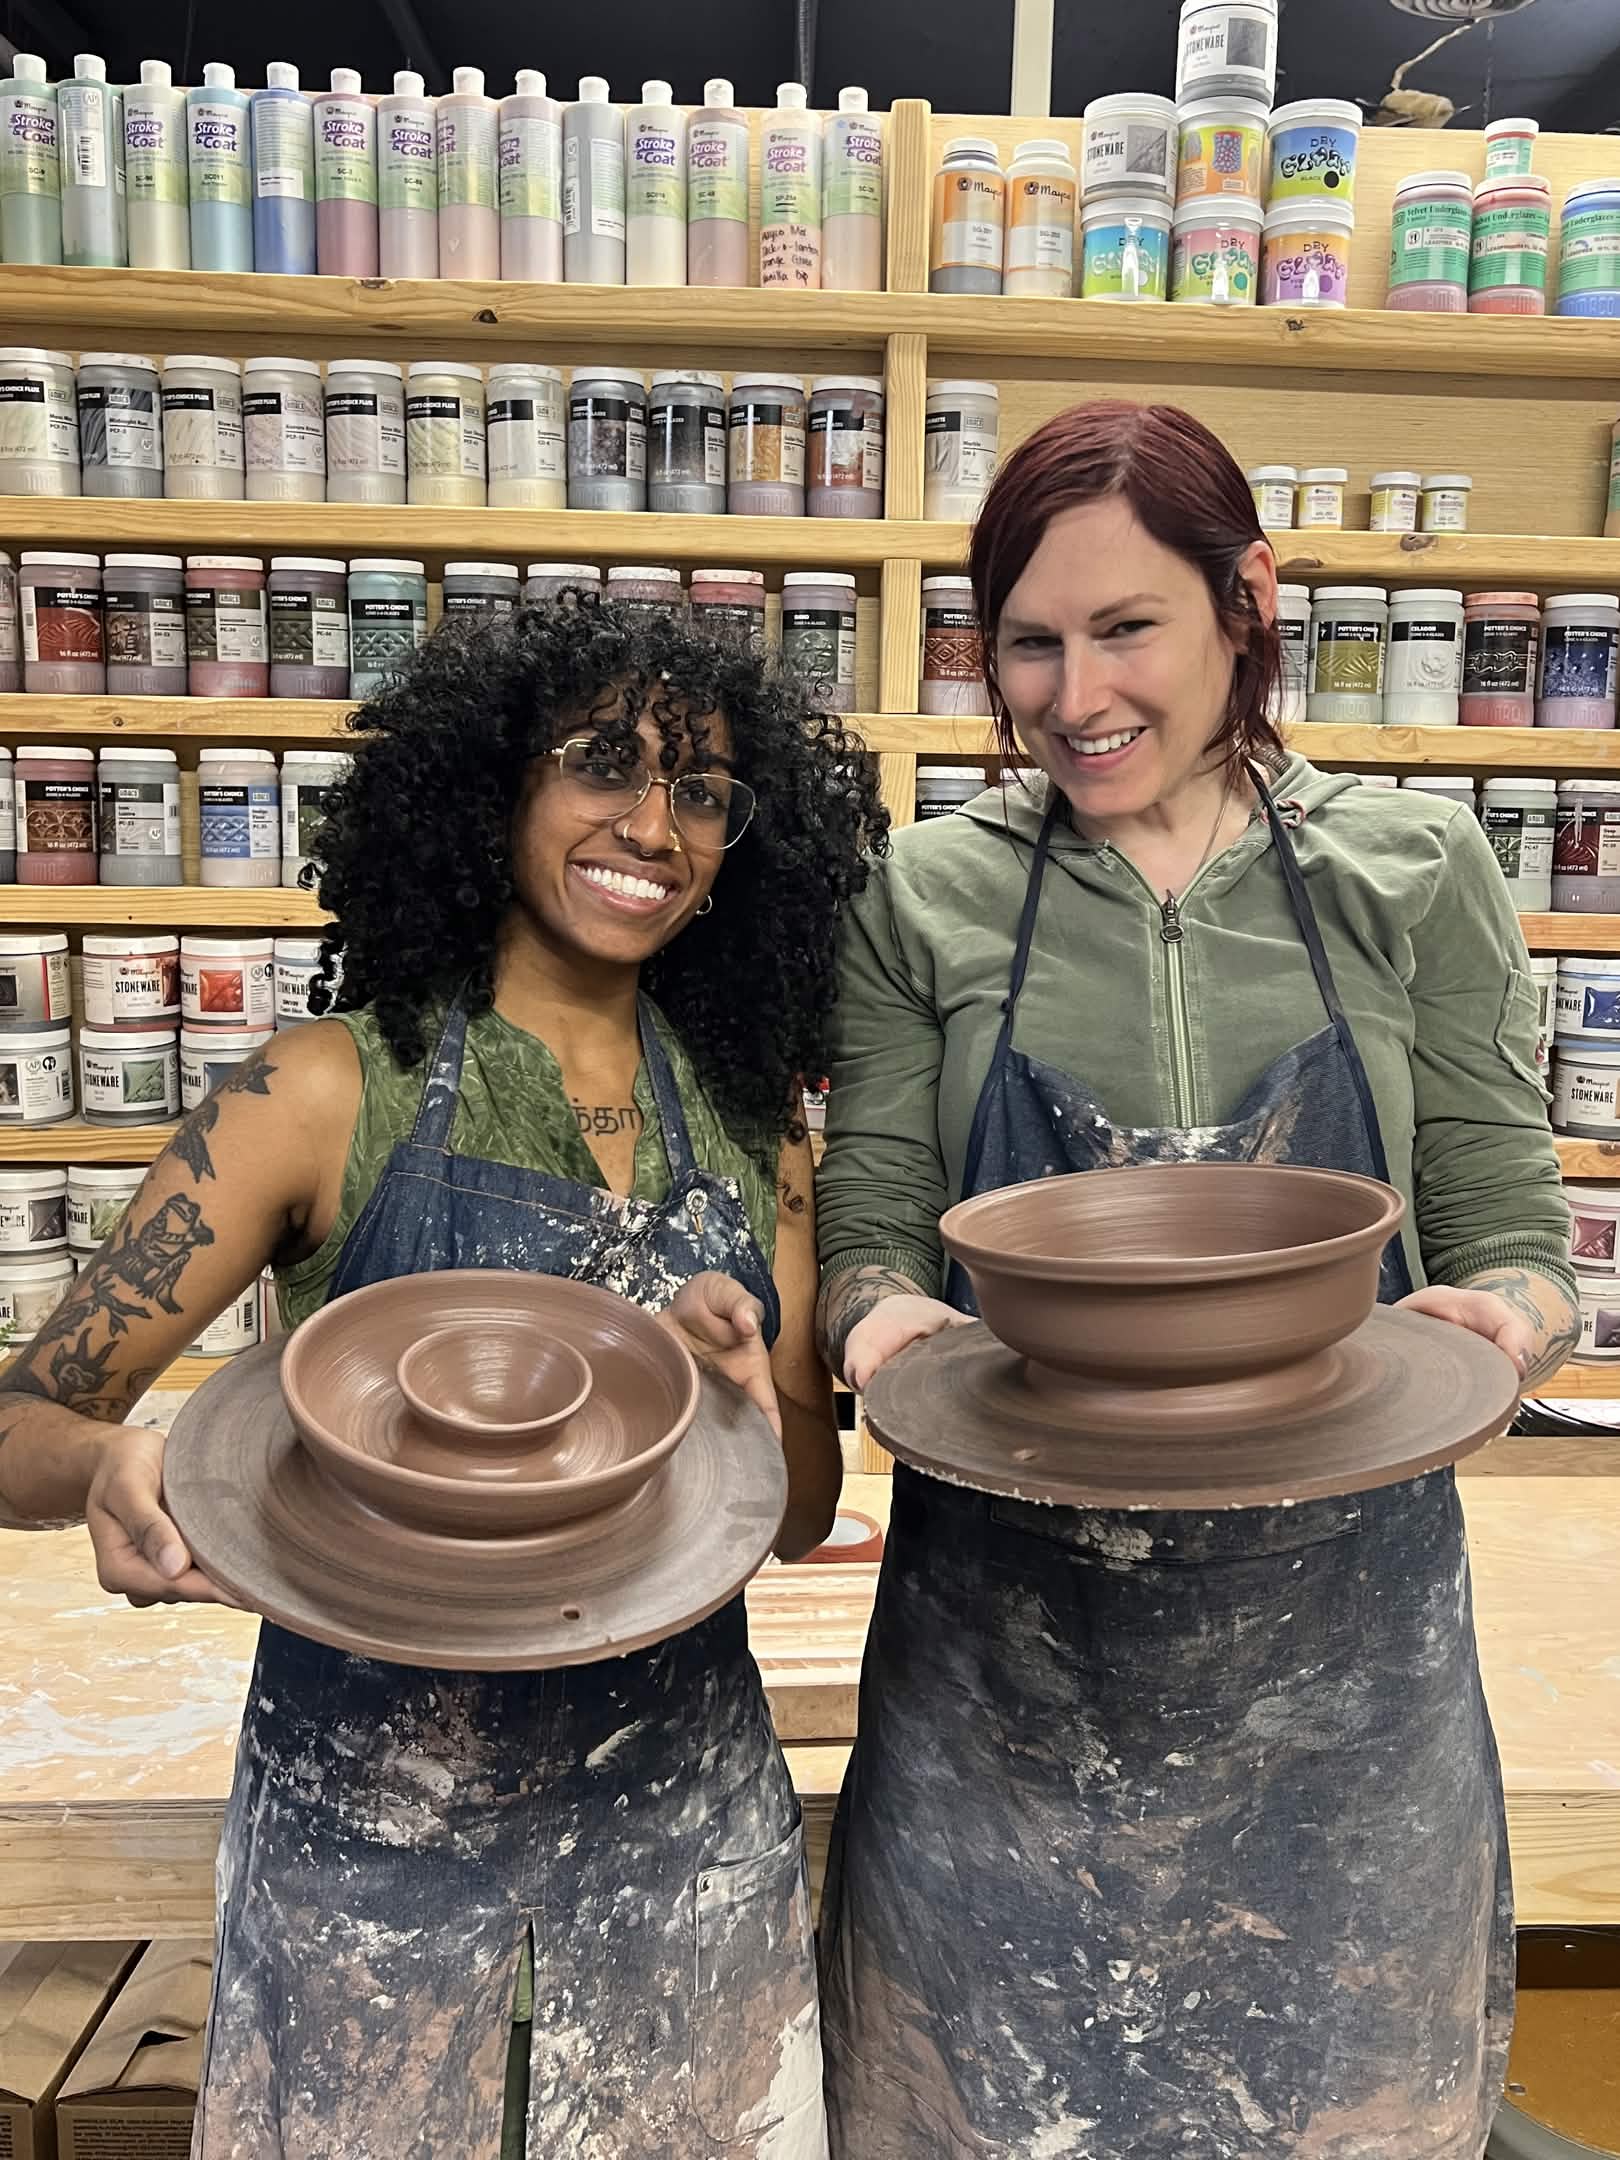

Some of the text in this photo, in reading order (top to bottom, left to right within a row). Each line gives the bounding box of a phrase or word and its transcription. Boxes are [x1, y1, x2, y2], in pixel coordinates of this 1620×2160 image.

[14, 114, 53, 130] Stroke
[325, 120, 364, 134] Stroke
[196, 122, 235, 137] Stroke
[22, 130, 55, 147] Coat
[333, 134, 366, 150] Coat
[393, 129, 430, 145] Stroke
[1310, 136, 1337, 148] DRY
[203, 137, 237, 152] Coat
[637, 138, 673, 151] Stroke
[691, 141, 725, 153] Stroke
[400, 145, 433, 161] Coat
[644, 151, 675, 167] Coat
[769, 148, 803, 160] Stroke
[697, 156, 727, 169] Coat
[775, 161, 806, 174] Coat
[1119, 237, 1145, 247] DY
[1221, 237, 1246, 249] DRY
[1304, 241, 1329, 253] DRY
[57, 591, 83, 599] POTTER'S
[365, 603, 409, 611] POTTER'S CHOICE
[1337, 625, 1362, 633] POTTER'S
[1410, 625, 1438, 633] CELADON
[1484, 625, 1508, 633] POTTER'S
[115, 978, 160, 993] STONEWARE
[85, 1073, 120, 1088] STONEWARE
[1571, 1088, 1614, 1103] STONEWARE
